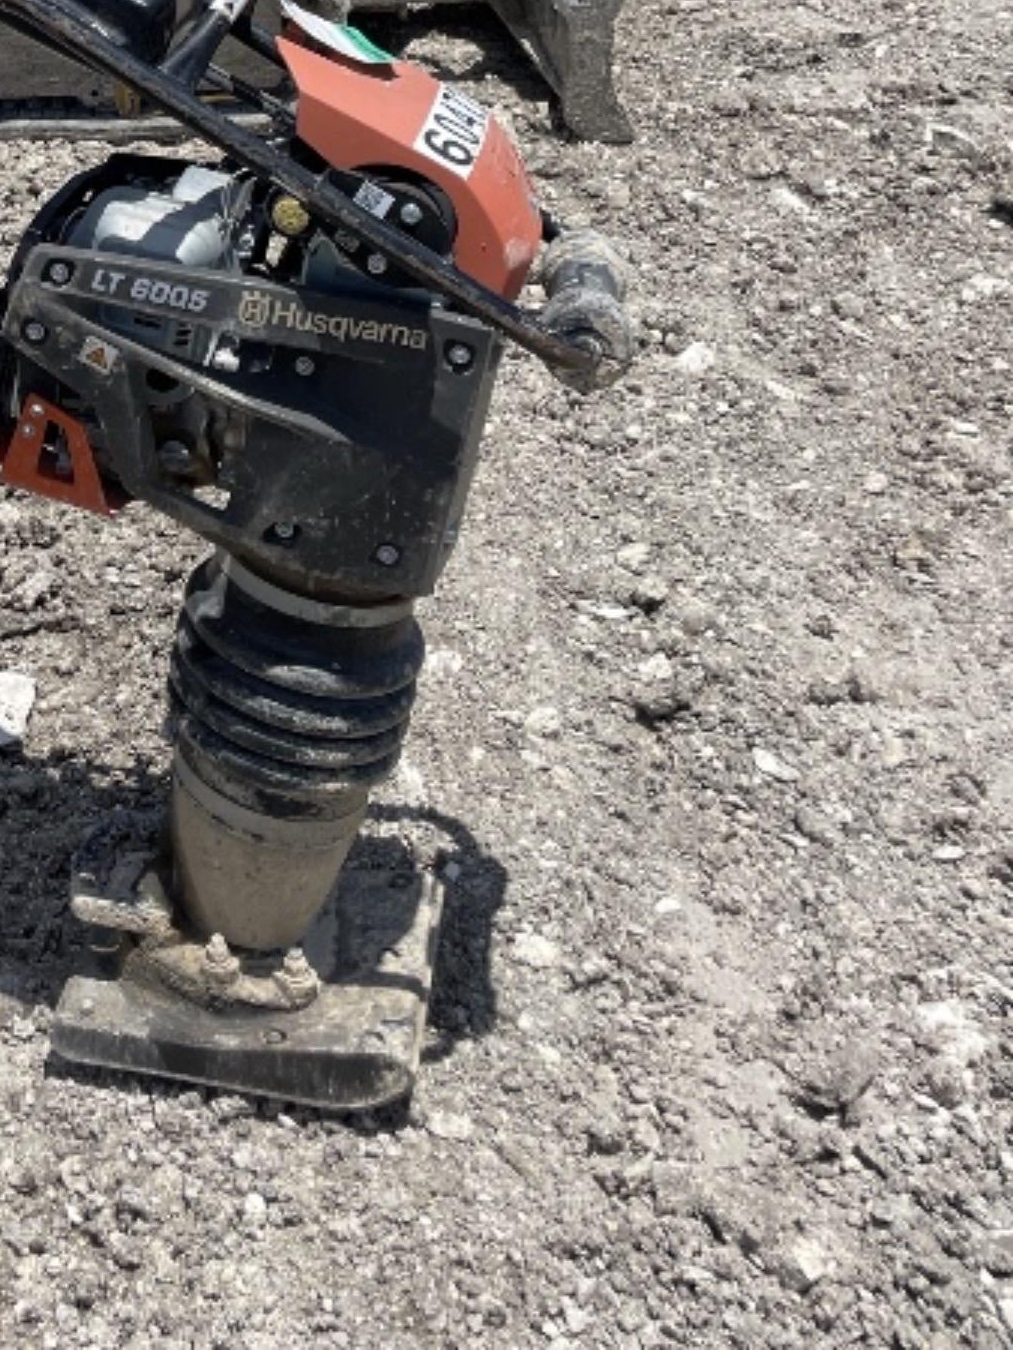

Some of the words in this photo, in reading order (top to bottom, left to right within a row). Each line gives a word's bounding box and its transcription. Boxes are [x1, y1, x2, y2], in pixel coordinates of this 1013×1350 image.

[91, 269, 126, 293] LT
[130, 279, 211, 312] 6005
[271, 301, 430, 350] Husqvarna
